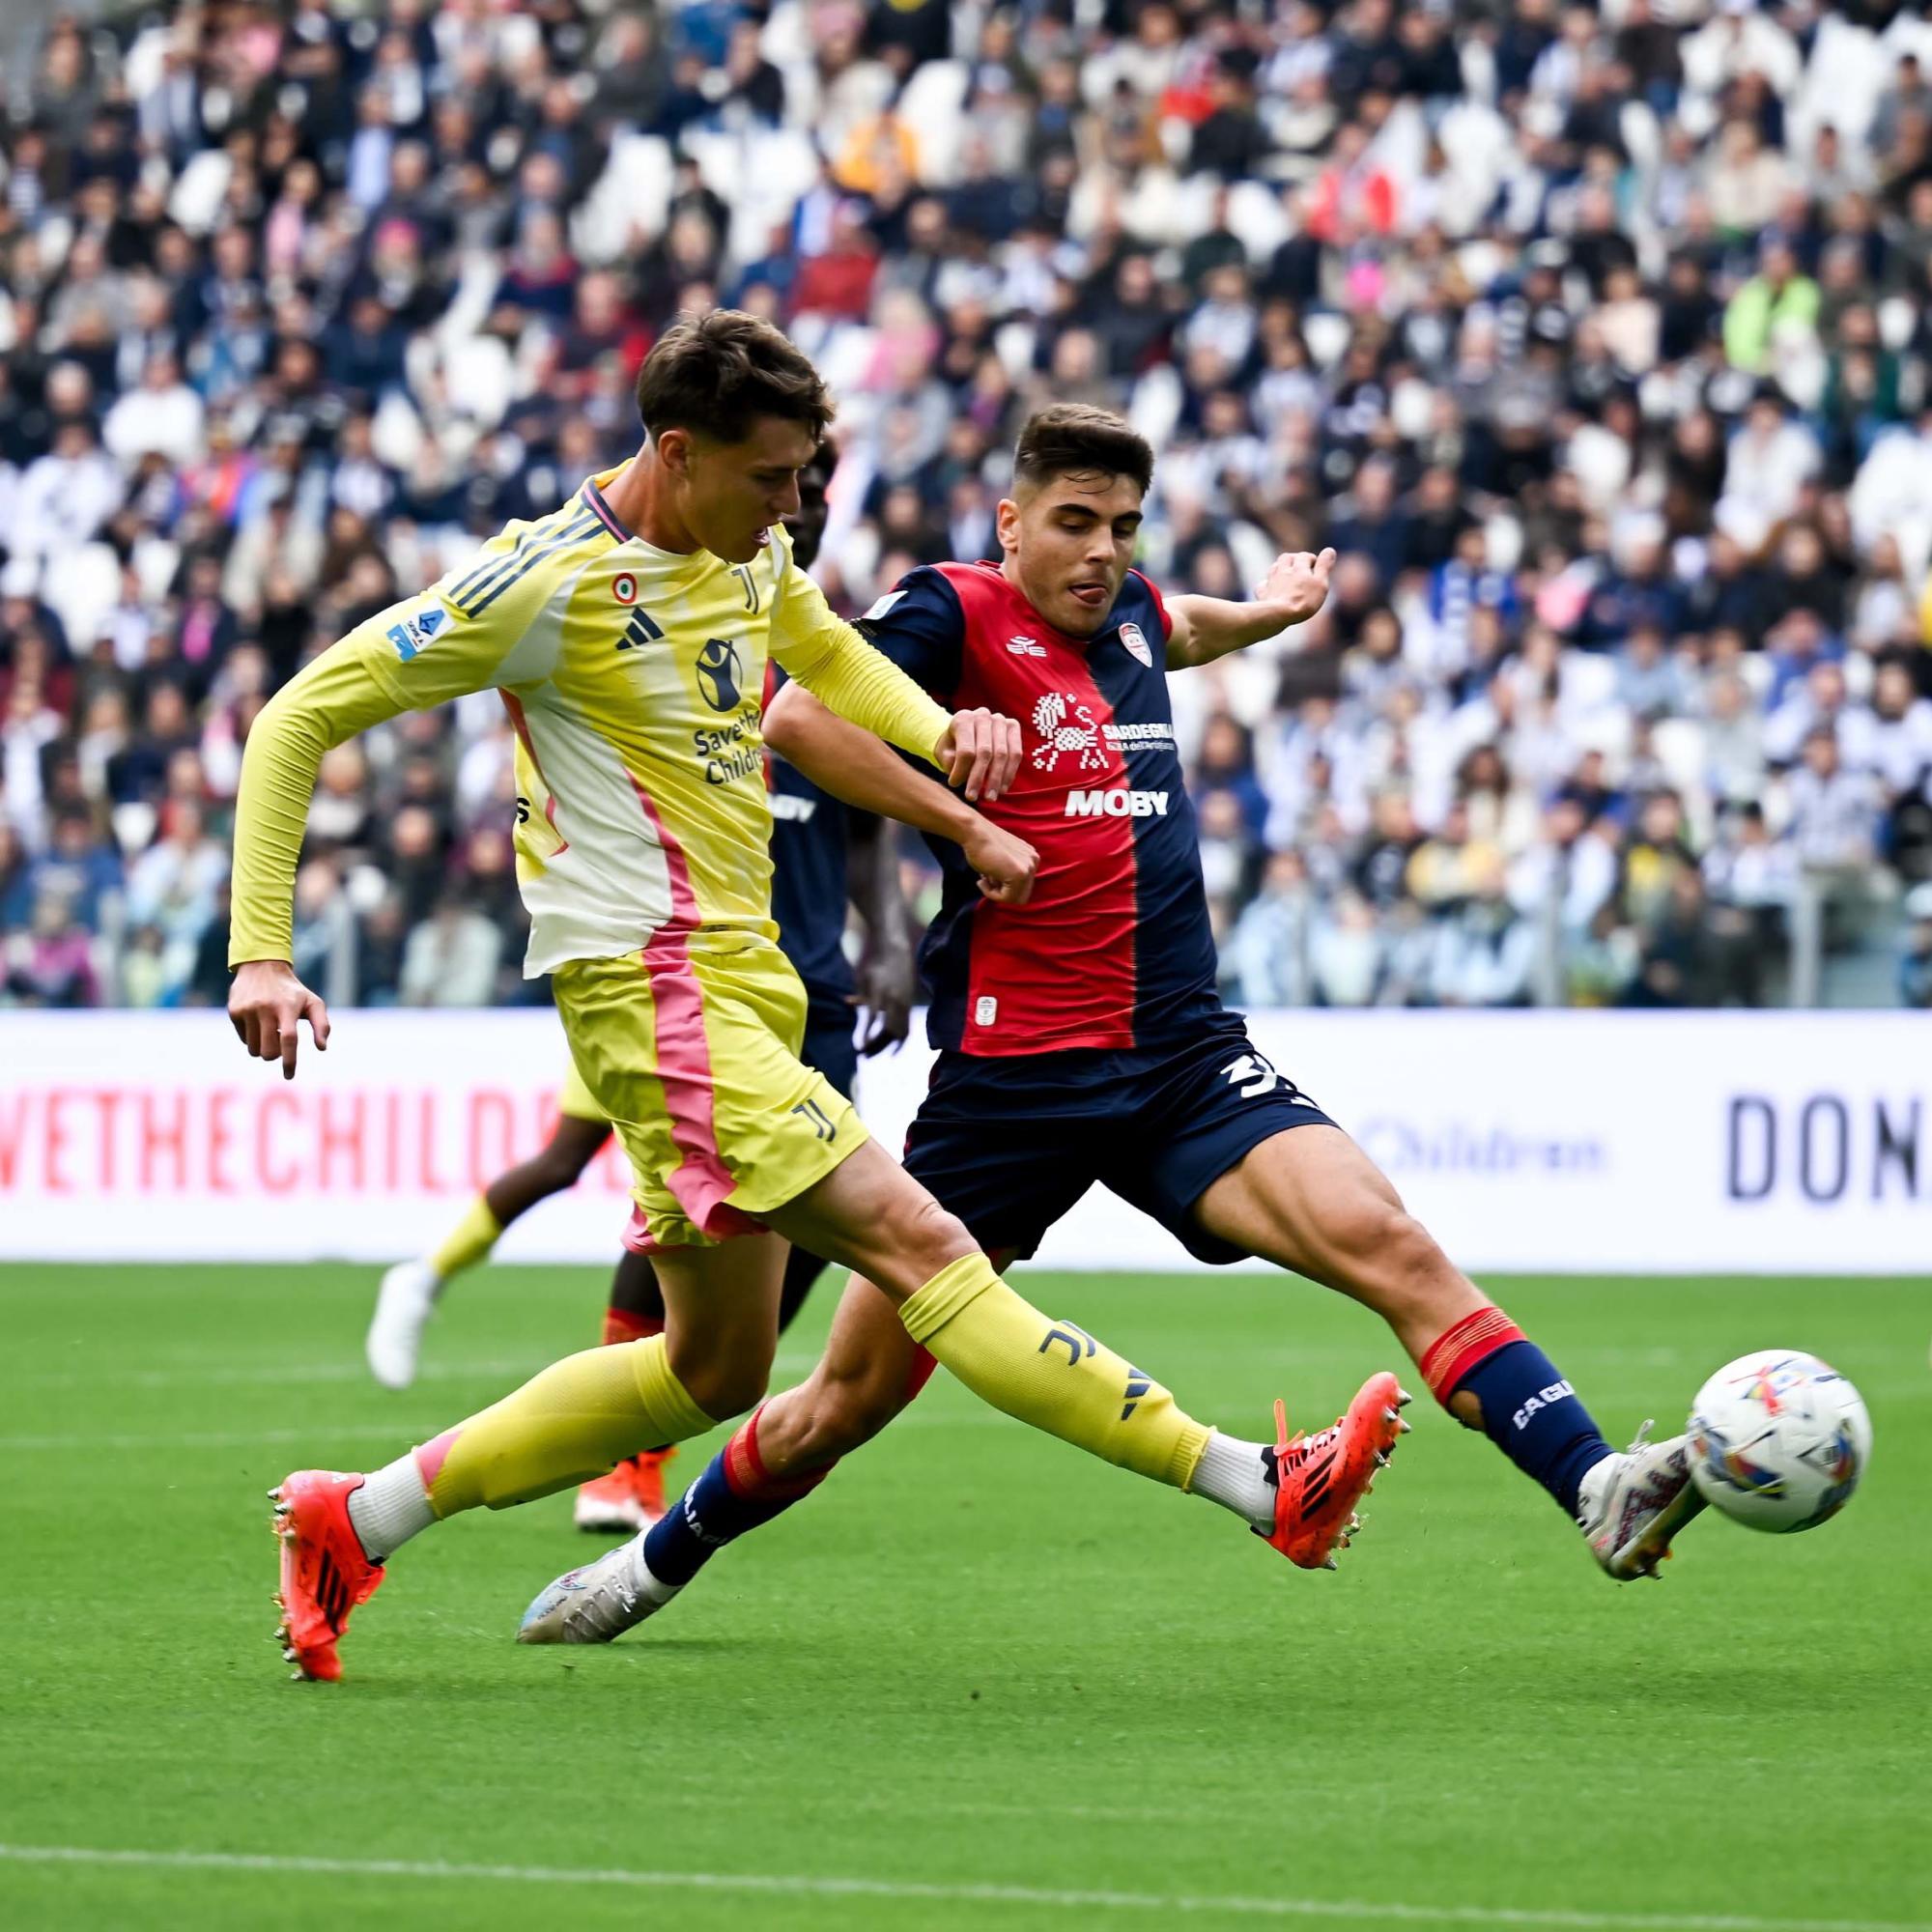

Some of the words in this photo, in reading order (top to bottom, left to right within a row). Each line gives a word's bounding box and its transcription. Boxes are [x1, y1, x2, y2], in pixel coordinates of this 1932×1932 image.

[694, 723, 744, 756] Save
[1101, 723, 1174, 741] SARDEGN
[705, 745, 762, 785] Childr
[1064, 789, 1170, 817] MOBY
